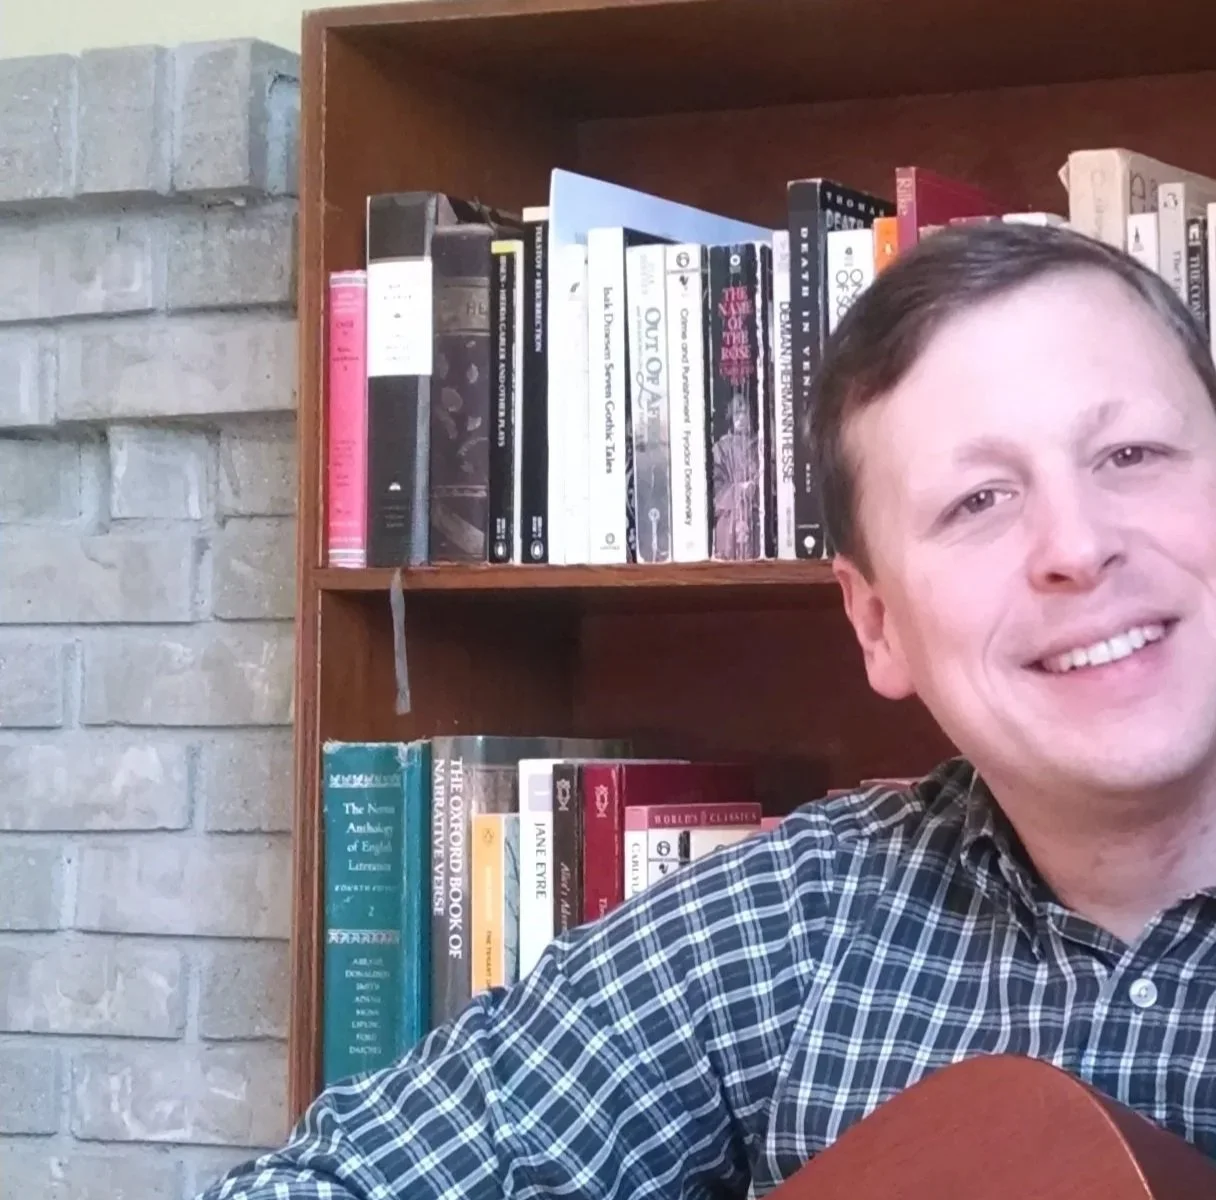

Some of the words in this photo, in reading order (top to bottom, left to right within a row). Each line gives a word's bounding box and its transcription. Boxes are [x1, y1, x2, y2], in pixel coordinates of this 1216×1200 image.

[896, 178, 913, 217] Rilke
[535, 226, 543, 270] TOLSTOY
[800, 227, 810, 299] DEATH
[534, 278, 543, 354] RESURRECTION
[603, 286, 613, 311] Isak
[644, 307, 662, 353] OUT
[680, 308, 690, 341] Crime
[801, 311, 811, 333] IN
[681, 343, 690, 363] and
[605, 364, 615, 400] Seven
[645, 357, 663, 387] OF
[681, 366, 691, 423] Punishment
[605, 401, 616, 441] Gothic
[606, 446, 616, 475] Tales
[683, 430, 692, 466] Fyodor
[782, 436, 795, 483] HESSE
[449, 757, 463, 796] THE
[342, 802, 365, 815] The
[433, 758, 446, 858] NARRATIVE
[653, 813, 699, 825] WORLD'S
[708, 811, 758, 824] CLASSICS
[346, 839, 360, 853] of
[449, 796, 464, 875] OXFORD
[533, 823, 547, 858] JANE
[432, 860, 446, 918] VERSE
[535, 862, 548, 900] EYRE
[560, 861, 571, 897] Alice's
[449, 876, 464, 932] BOOK
[449, 933, 462, 960] OF
